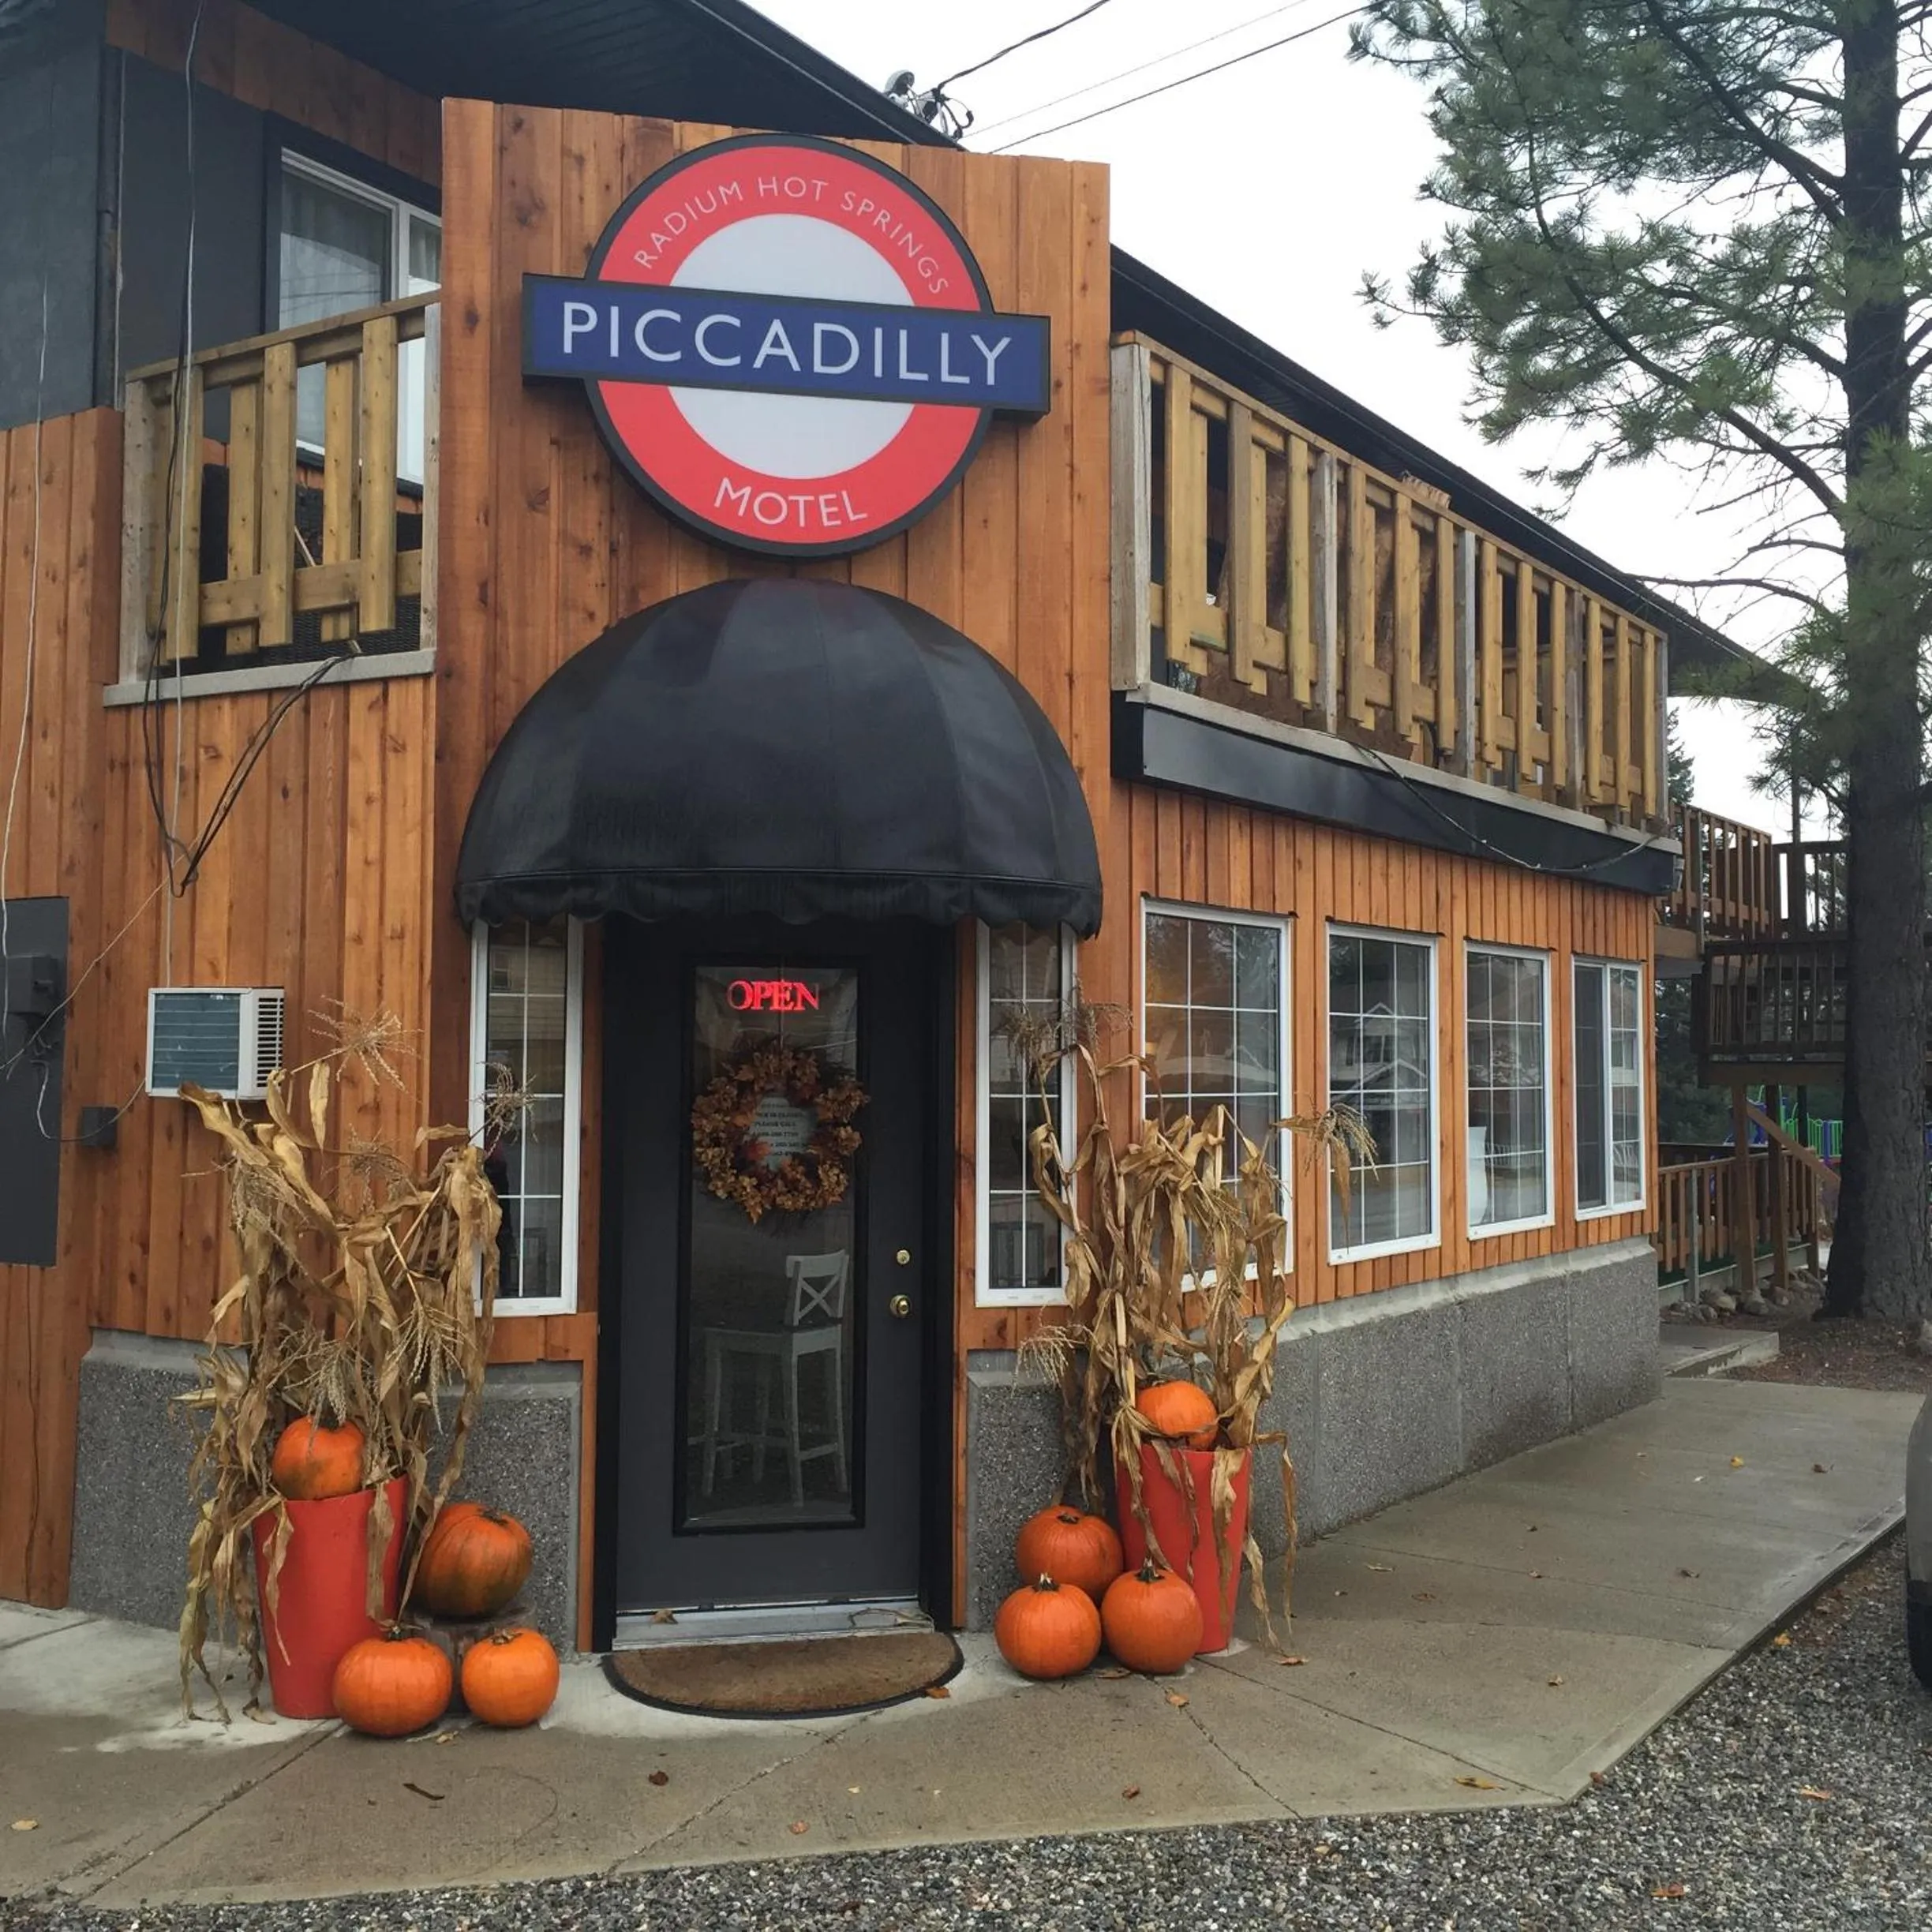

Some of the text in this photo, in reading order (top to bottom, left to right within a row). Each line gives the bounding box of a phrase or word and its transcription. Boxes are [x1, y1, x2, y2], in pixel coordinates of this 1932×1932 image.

[634, 176, 949, 293] RADIUM HOT SPRINGS
[564, 302, 1011, 385] PICCADILLY
[714, 477, 867, 526] MOTEL
[728, 980, 819, 1010] OPEN
